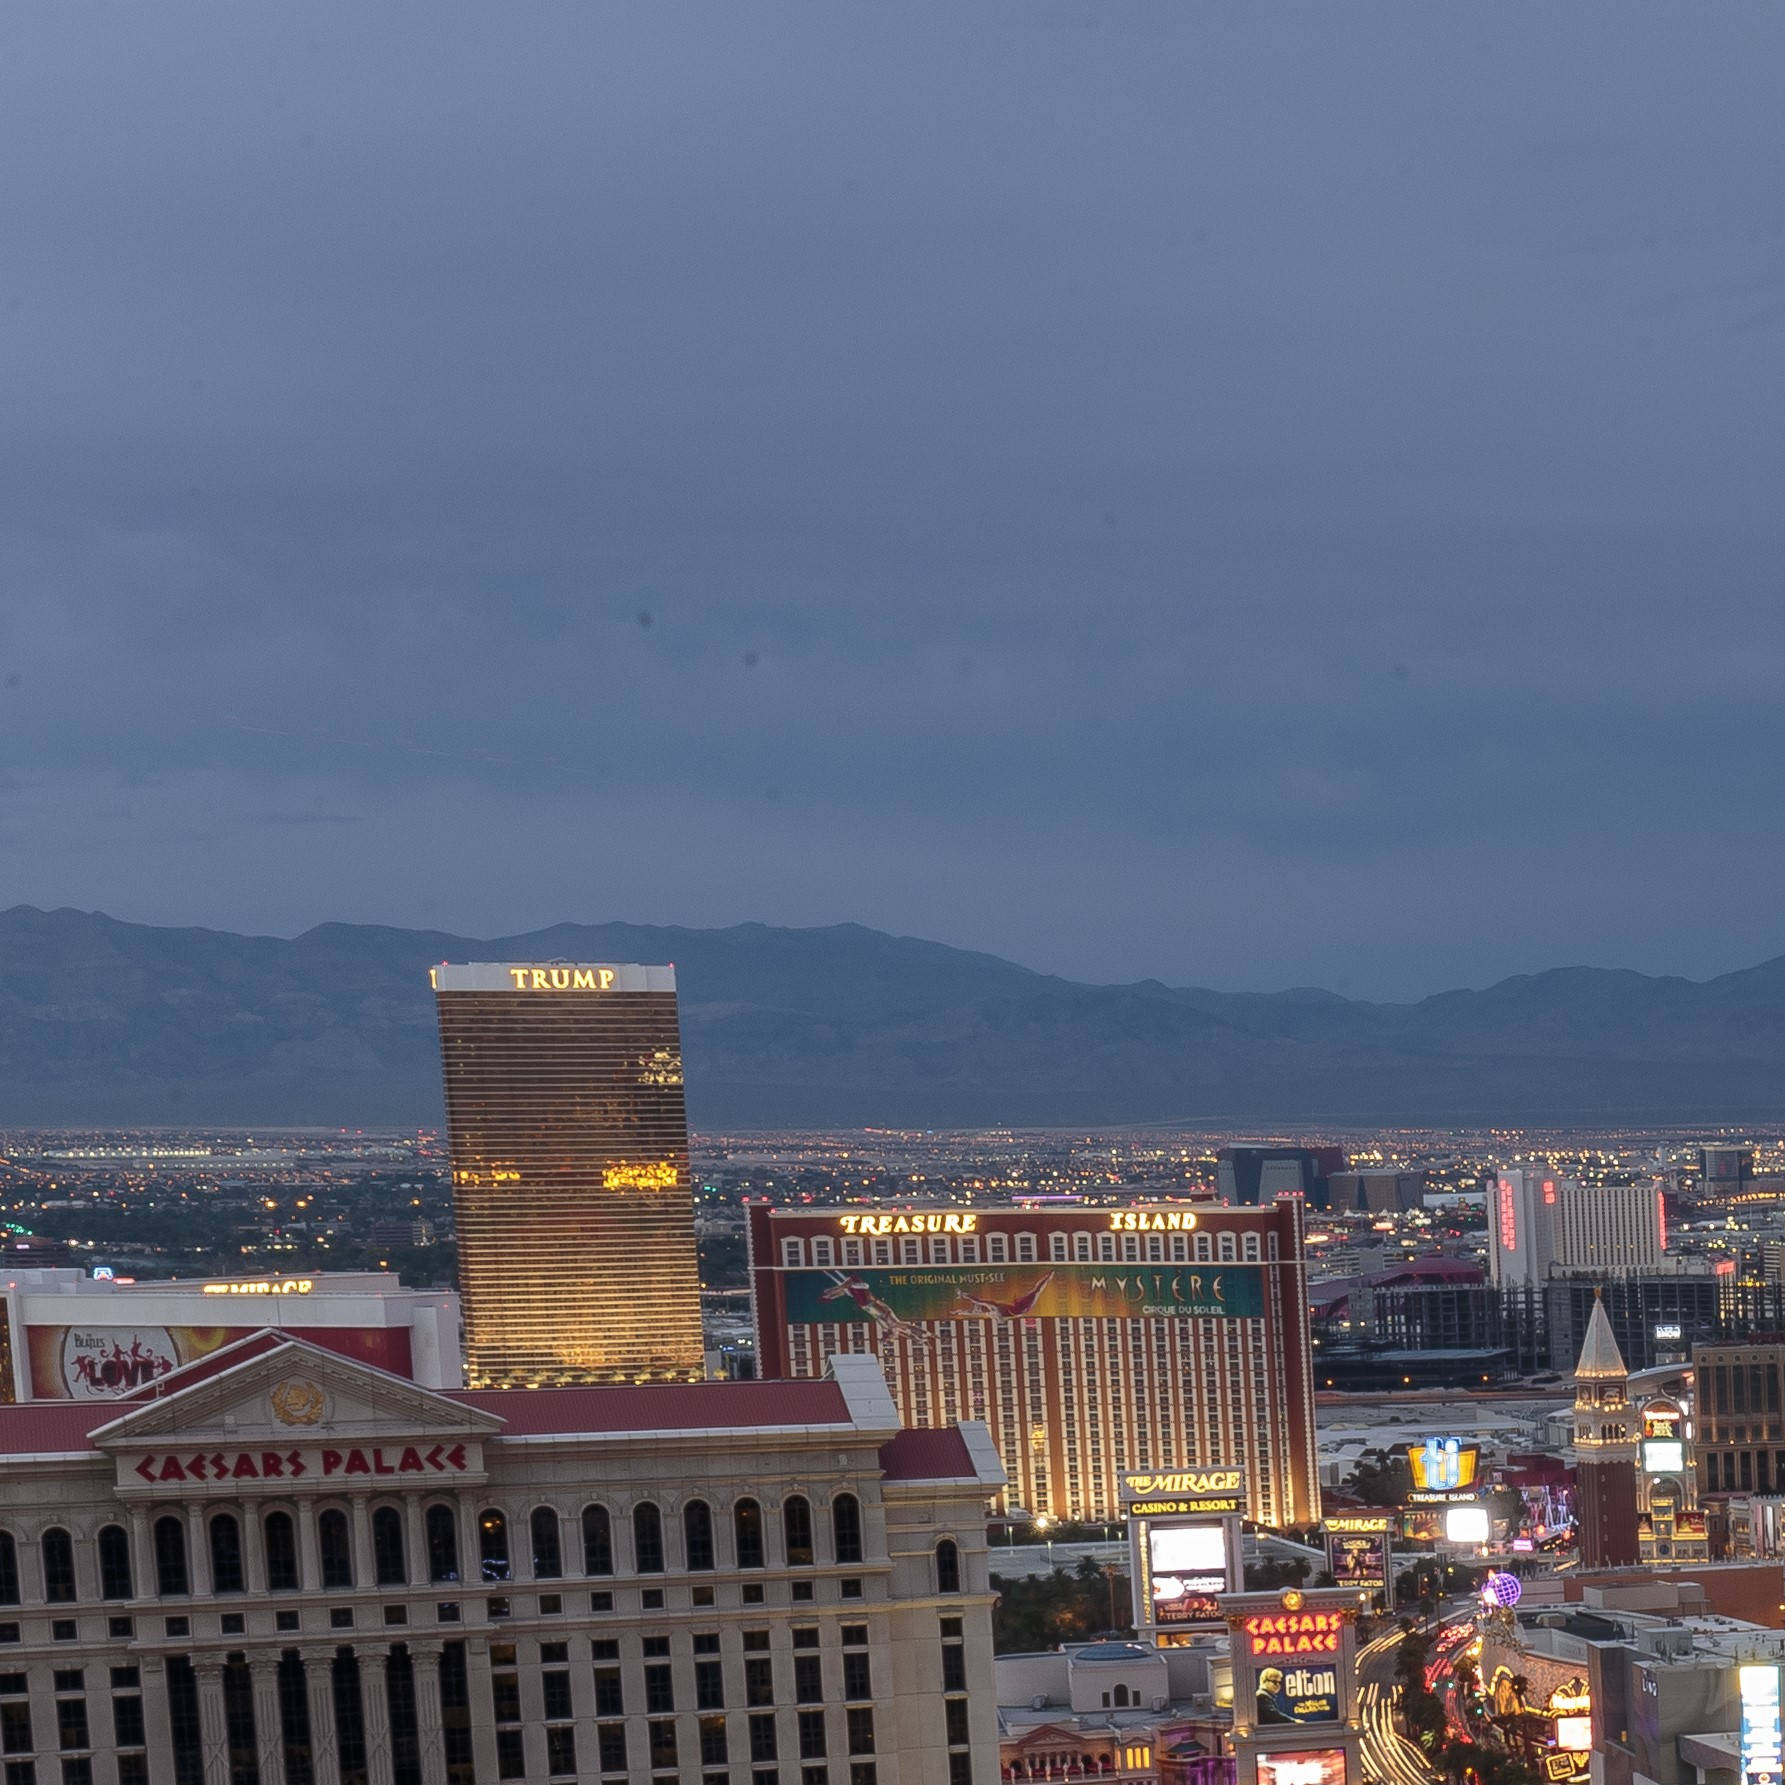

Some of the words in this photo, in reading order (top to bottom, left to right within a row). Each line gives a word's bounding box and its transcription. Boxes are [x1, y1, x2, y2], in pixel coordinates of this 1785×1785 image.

[510, 967, 615, 990] TRUMP
[840, 1214, 977, 1235] TREASURE
[1110, 1212, 1198, 1230] ISLAND
[889, 1275, 908, 1285] THE
[910, 1274, 957, 1284] ORIGINAL
[1142, 1305, 1176, 1316] CIRQUE
[1178, 1305, 1192, 1314] DU
[1193, 1305, 1226, 1315] SOLEIL
[134, 1449, 307, 1484] CAESARS
[321, 1443, 468, 1476] PALACE
[1125, 1475, 1152, 1488] THE
[1136, 1472, 1241, 1494] MIRAGE
[1132, 1502, 1177, 1514] CASINO
[1178, 1502, 1188, 1512] &
[1190, 1500, 1238, 1512] RESORT
[1328, 1519, 1387, 1532] MIRAGE
[1246, 1613, 1341, 1635] CAESARS
[1252, 1633, 1338, 1655] PALACE
[1285, 1670, 1335, 1697] elton
